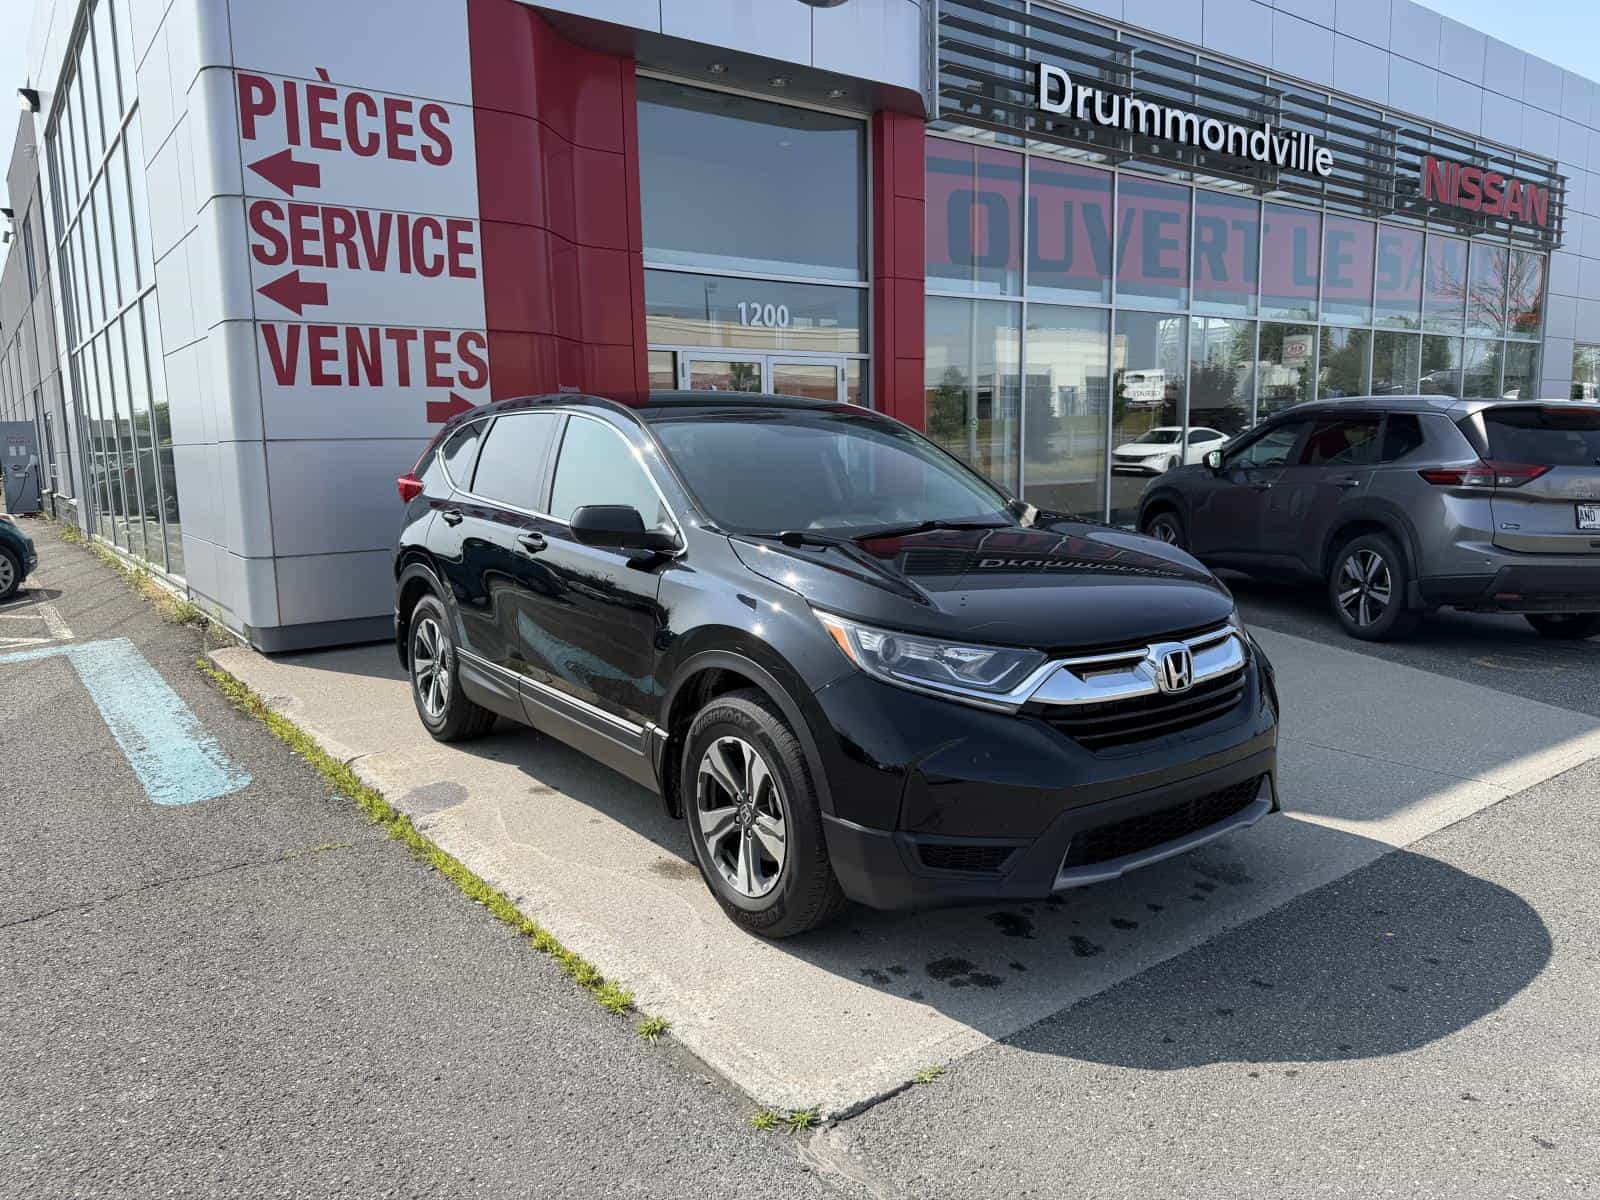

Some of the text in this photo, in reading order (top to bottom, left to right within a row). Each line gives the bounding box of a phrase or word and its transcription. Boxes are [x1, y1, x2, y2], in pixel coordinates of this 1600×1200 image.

[237, 67, 453, 167] PIÈCES
[1039, 63, 1335, 177] Drummondville
[1420, 155, 1549, 228] NISSAN
[249, 200, 477, 279] SERVICE
[947, 188, 1270, 284] OUVERT
[737, 301, 789, 327] 1200
[260, 324, 489, 389] VENTES
